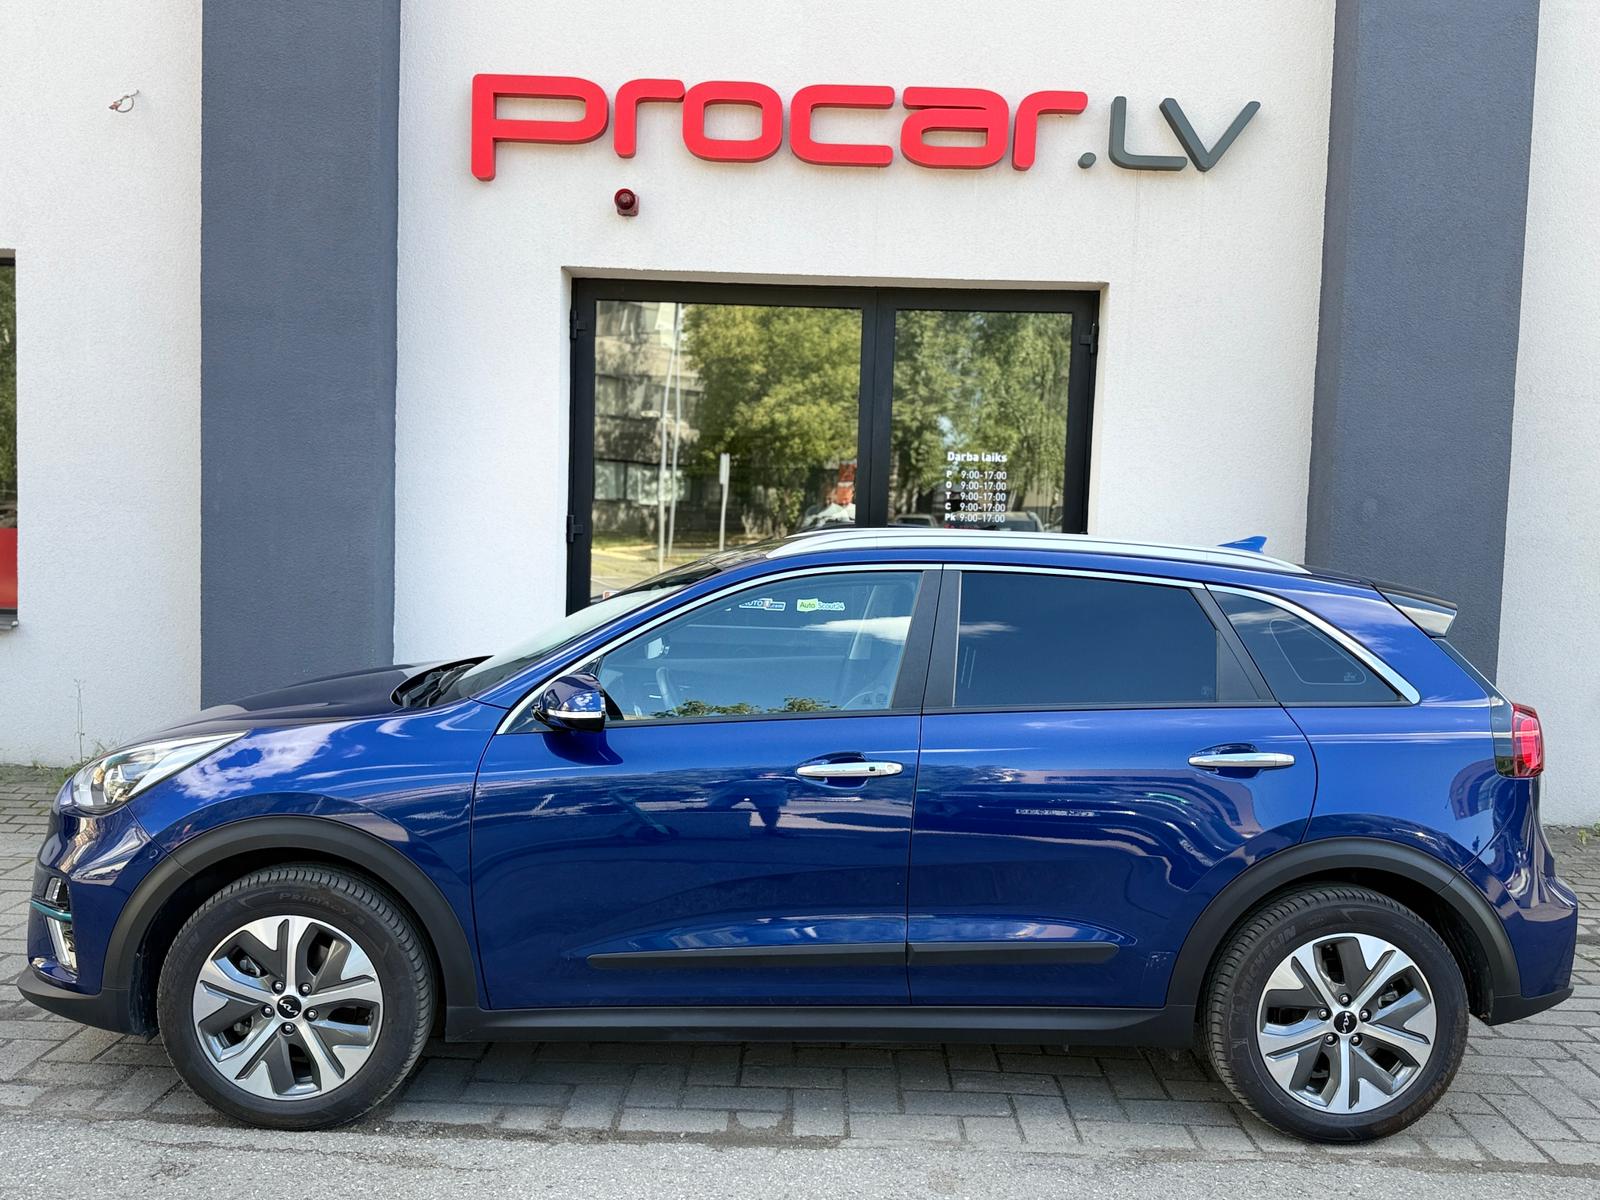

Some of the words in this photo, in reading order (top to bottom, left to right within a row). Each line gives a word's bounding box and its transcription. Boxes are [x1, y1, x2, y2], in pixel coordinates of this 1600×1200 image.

[947, 451, 979, 462] Darba
[981, 452, 1008, 463] laiks
[946, 470, 952, 478] P
[961, 470, 1007, 480] 9:00-17:00
[946, 481, 952, 489] O
[960, 481, 1006, 491] 9:00-17:00
[945, 492, 952, 500] T
[960, 492, 1006, 502] 9:00-17:00
[945, 502, 952, 510] C
[960, 502, 1005, 512] 9:00-17:00
[945, 513, 956, 521] Pk
[960, 513, 1005, 523] 9:00-17:00
